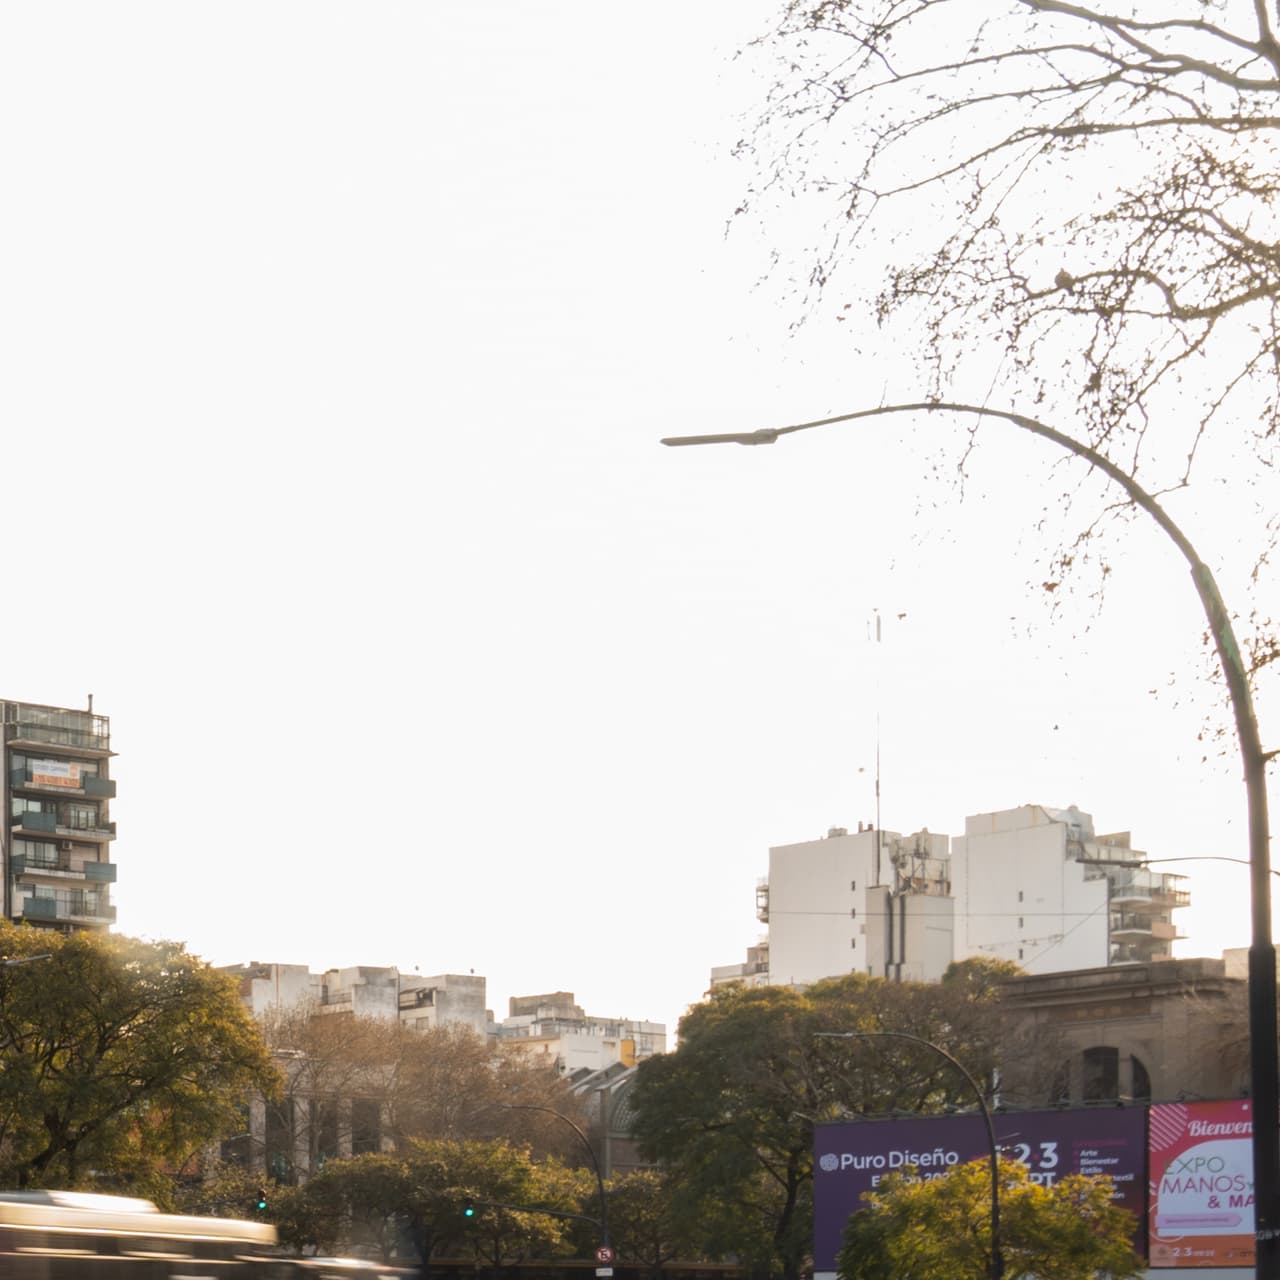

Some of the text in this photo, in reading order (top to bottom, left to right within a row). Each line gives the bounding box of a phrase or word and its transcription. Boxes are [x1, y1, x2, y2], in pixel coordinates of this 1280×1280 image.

[840, 1148, 959, 1170] Puro Diseño
[1164, 1156, 1225, 1175] EXPO
[1162, 1175, 1246, 1195] MANOS
[1207, 1195, 1221, 1209] &
